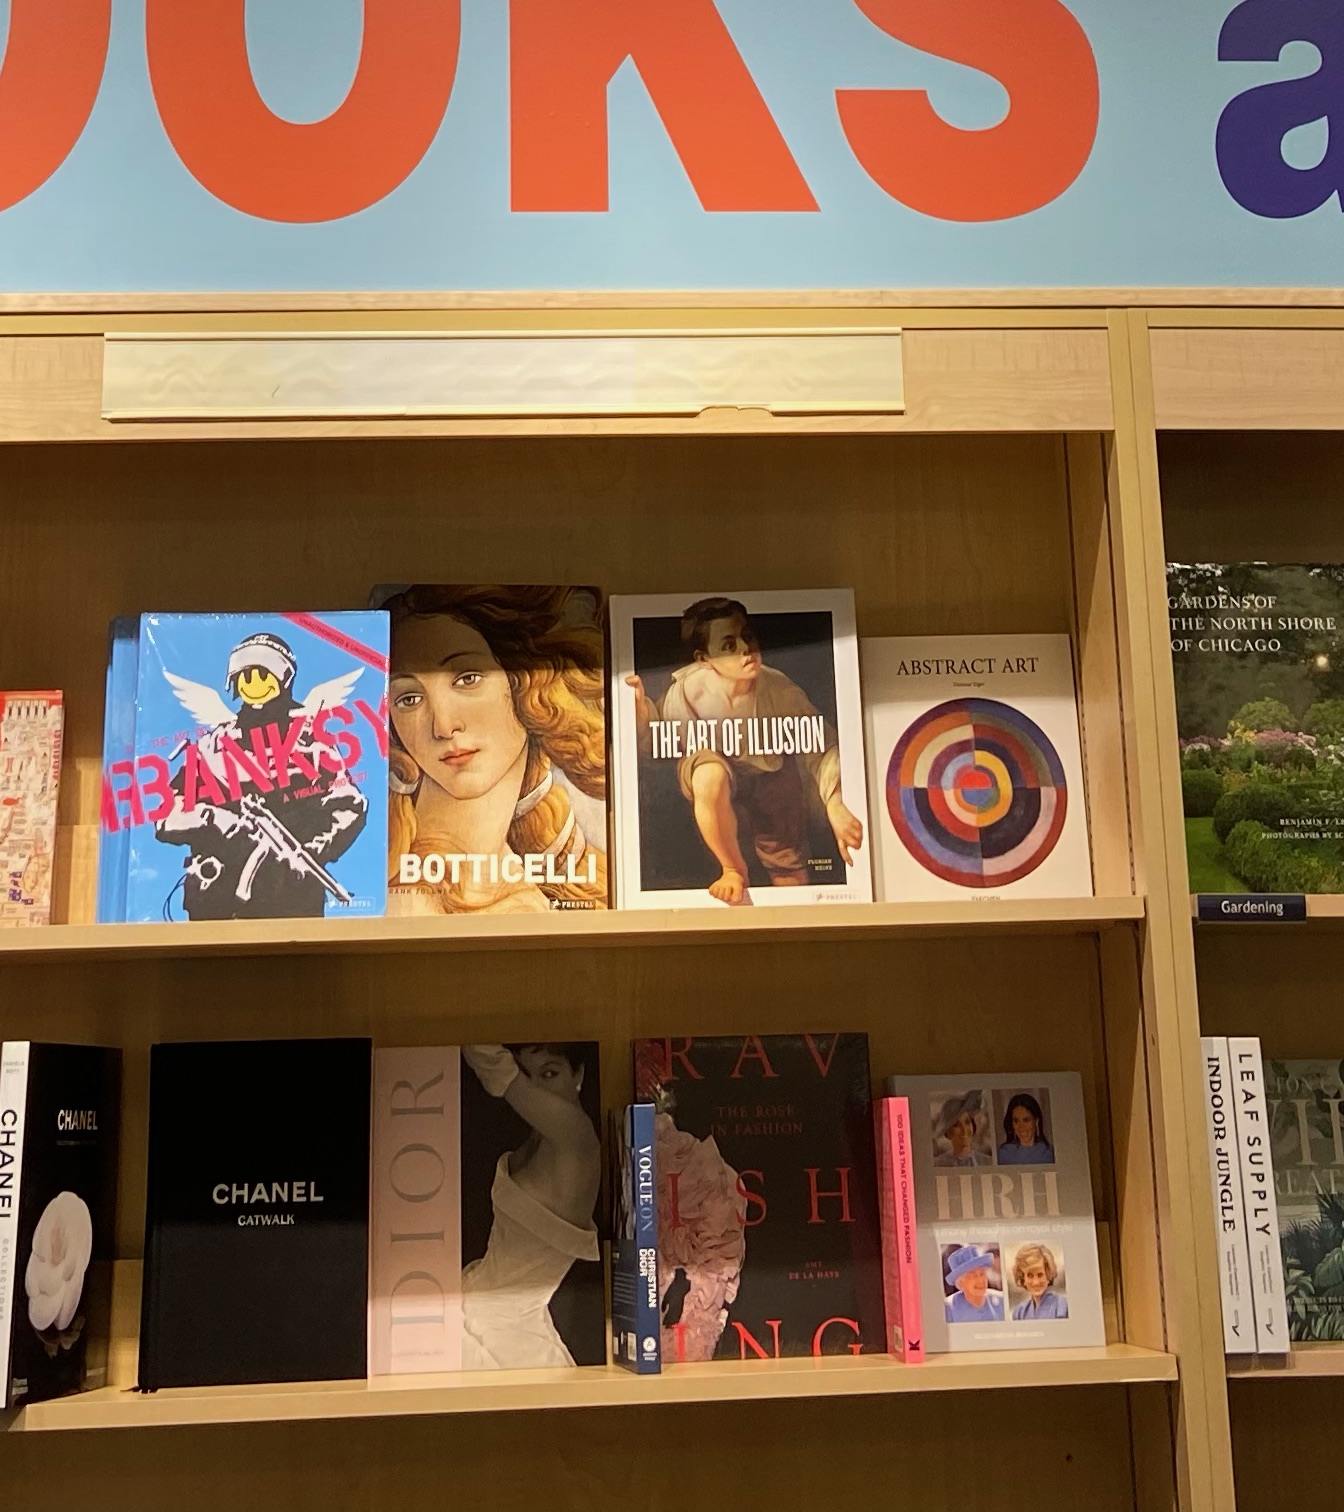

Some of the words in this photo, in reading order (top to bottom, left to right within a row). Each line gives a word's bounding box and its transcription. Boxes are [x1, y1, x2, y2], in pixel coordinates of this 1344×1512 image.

[1168, 596, 1251, 610] GARDENS
[1255, 596, 1277, 609] OF
[1170, 617, 1205, 631] THE
[1210, 617, 1273, 631] NORTH
[1278, 617, 1337, 631] SHORE
[1171, 639, 1192, 652] OF
[1198, 639, 1281, 652] CHICAGO
[896, 658, 997, 676] ABSTRACT
[1002, 657, 1039, 674] ART
[649, 720, 682, 759] THE
[722, 718, 743, 757] OF
[747, 715, 825, 756] ILLUSION
[399, 853, 597, 885] BOTTICELLI
[1221, 899, 1284, 916] Gardening
[1207, 1056, 1227, 1141] INDOOR
[1238, 1053, 1259, 1122] LEAF
[58, 1108, 98, 1131] CHANEL
[735, 1121, 803, 1136] FASHION
[638, 1144, 654, 1207] VOGUE
[1247, 1135, 1271, 1237] SUPPLY
[212, 1181, 324, 1204] CHANEL
[390, 1071, 446, 1330] DIOR
[1215, 1147, 1236, 1233] JUNGLE
[237, 1213, 295, 1227] CATWALK
